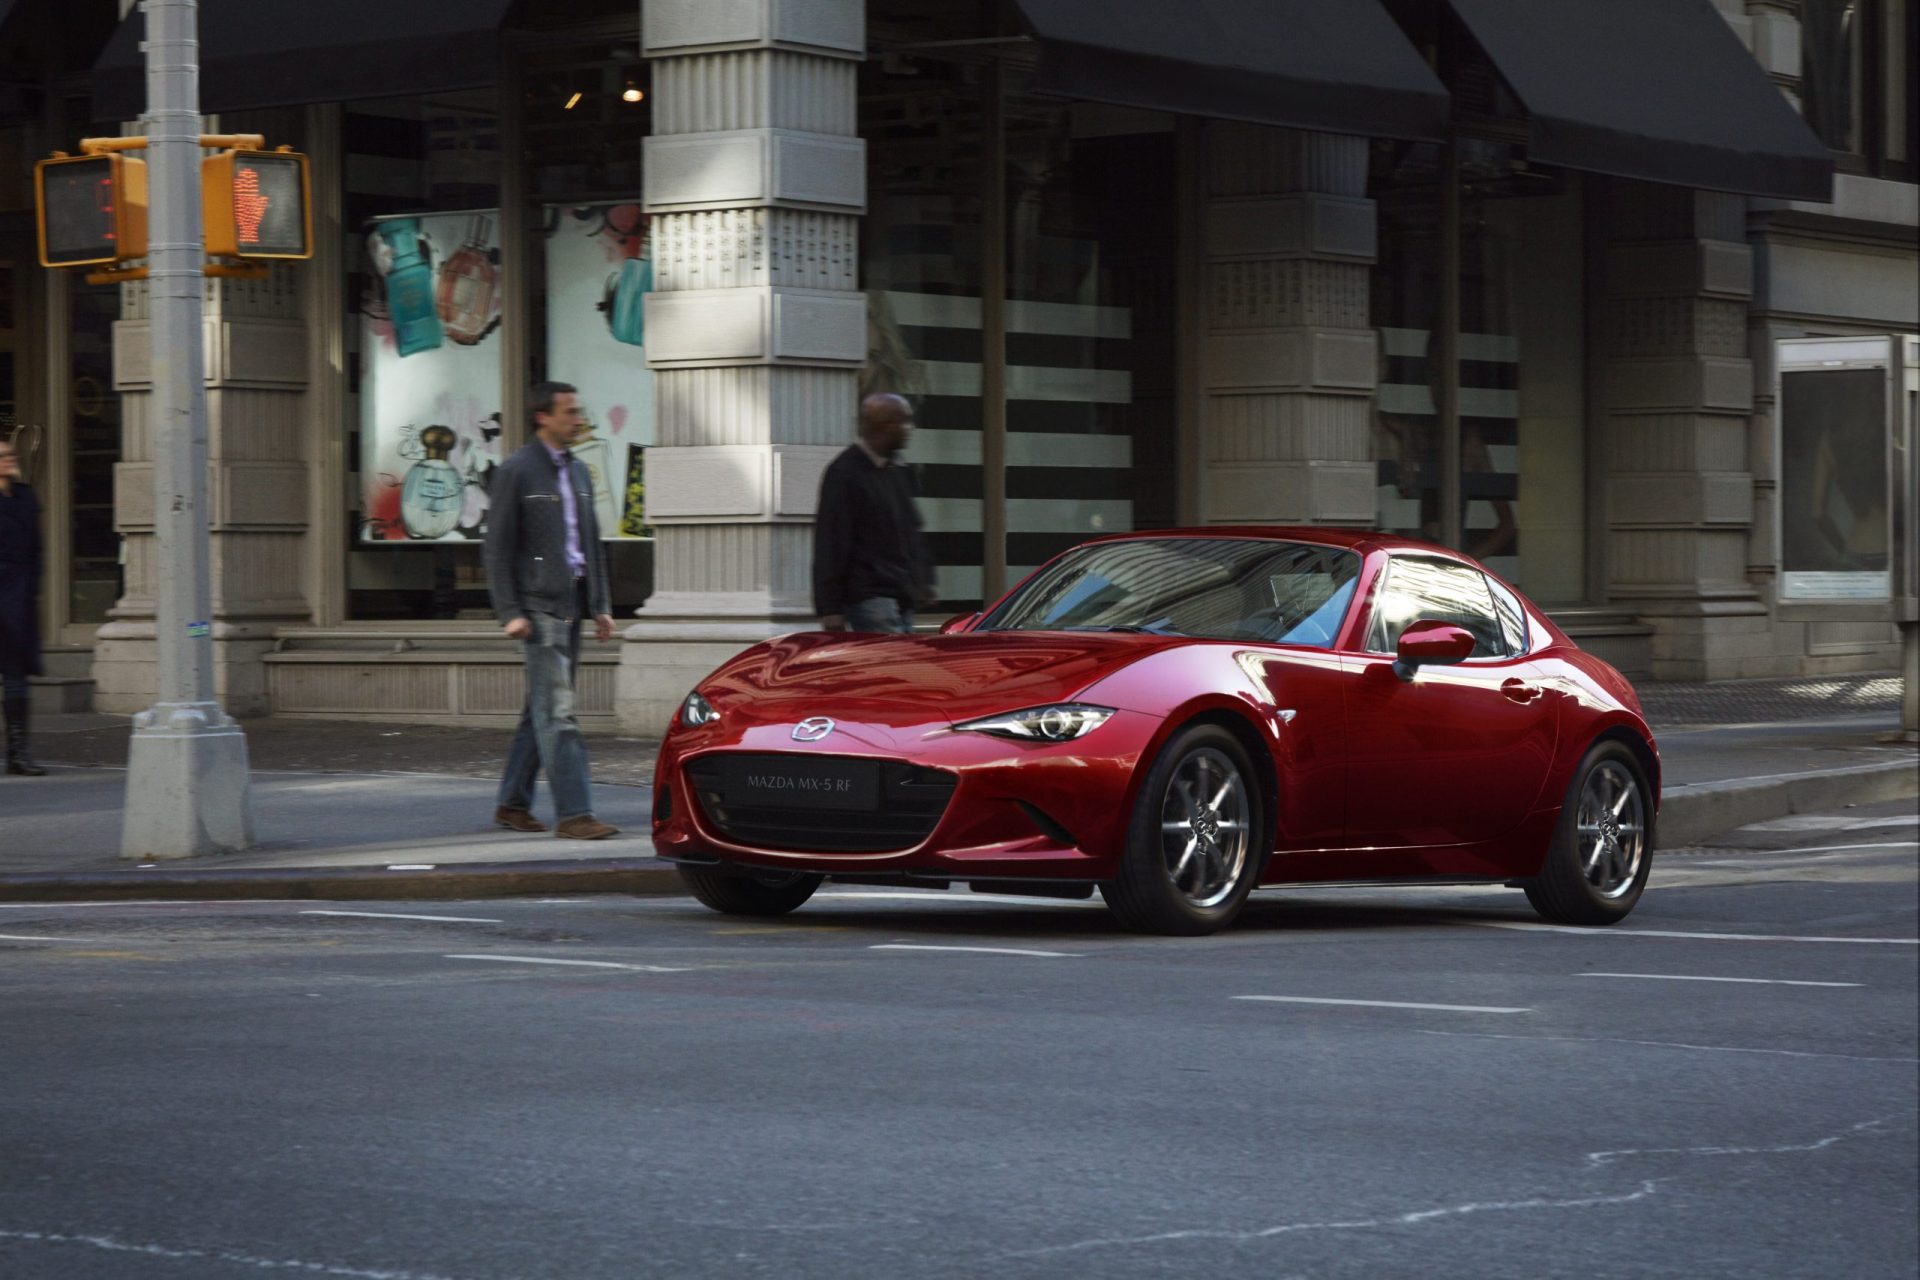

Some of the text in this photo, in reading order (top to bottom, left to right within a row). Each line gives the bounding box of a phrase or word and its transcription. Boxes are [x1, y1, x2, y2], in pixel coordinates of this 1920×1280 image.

[748, 775, 851, 792] MAZDA MX-5 RF
